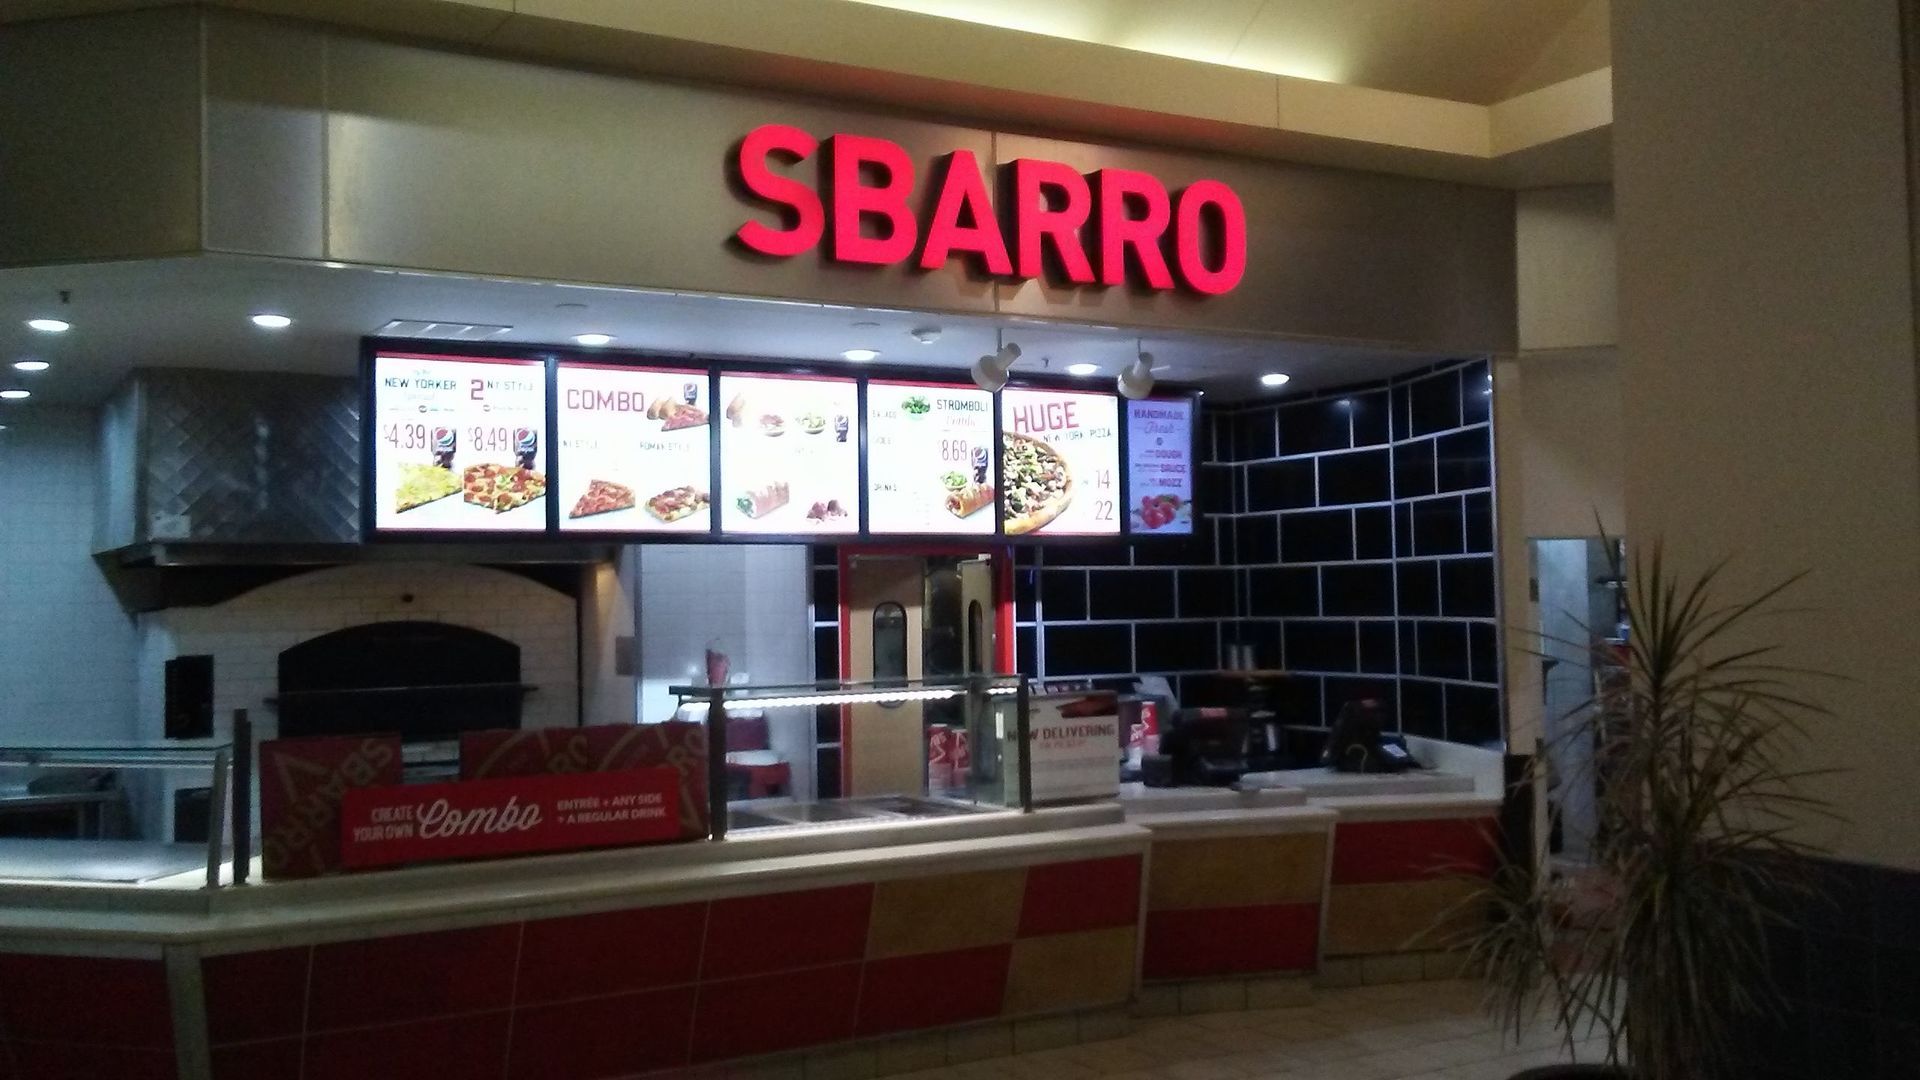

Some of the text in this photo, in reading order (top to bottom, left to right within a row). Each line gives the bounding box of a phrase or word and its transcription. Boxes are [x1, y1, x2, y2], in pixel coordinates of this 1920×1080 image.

[735, 123, 1248, 296] SBARRO
[384, 377, 457, 391] NEW YORKER
[470, 379, 484, 401] 2
[567, 388, 645, 412] COMBO
[936, 399, 988, 412] STROMBOLI
[1012, 401, 1080, 433] HUGE
[1095, 500, 1114, 521] 22
[1007, 724, 1116, 742] NW DELIVERING
[612, 795, 637, 807] ANY
[638, 792, 663, 805] SIDE
[371, 804, 414, 823] CREATE
[416, 795, 543, 840] Combo
[566, 814, 576, 824] A
[577, 808, 630, 823] REGULAR
[631, 806, 667, 820] DRINK
[353, 823, 414, 842] YOUR OWN
